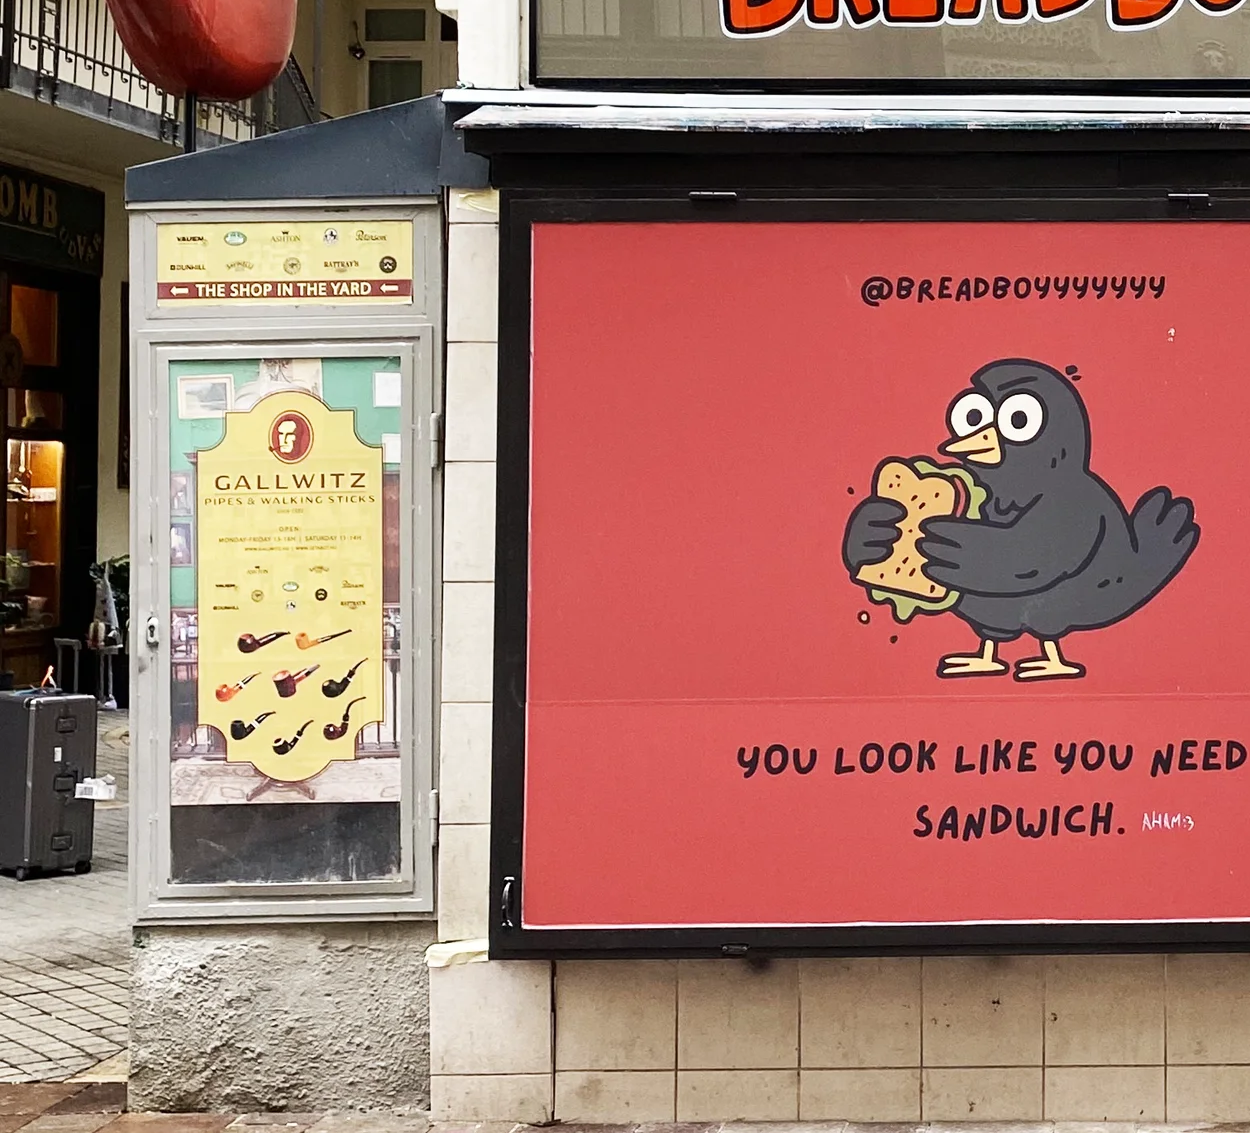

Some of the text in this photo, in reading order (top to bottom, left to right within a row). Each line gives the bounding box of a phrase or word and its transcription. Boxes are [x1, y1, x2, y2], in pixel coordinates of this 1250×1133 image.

[271, 235, 300, 243] ASHTON
[195, 281, 372, 298] THE SHOP IN THE YARD
[860, 275, 1166, 307] @BREADBOYYYYYYY
[214, 472, 366, 491] GALLWITZ
[204, 494, 376, 506] PIPES & WALKING STICKS
[737, 743, 818, 779] YOU
[834, 740, 938, 775] LOOK
[955, 739, 1038, 775] LIKE
[1054, 740, 1133, 776] YOU
[1150, 740, 1248, 777] NEED
[913, 802, 1127, 842] SANDWICH.
